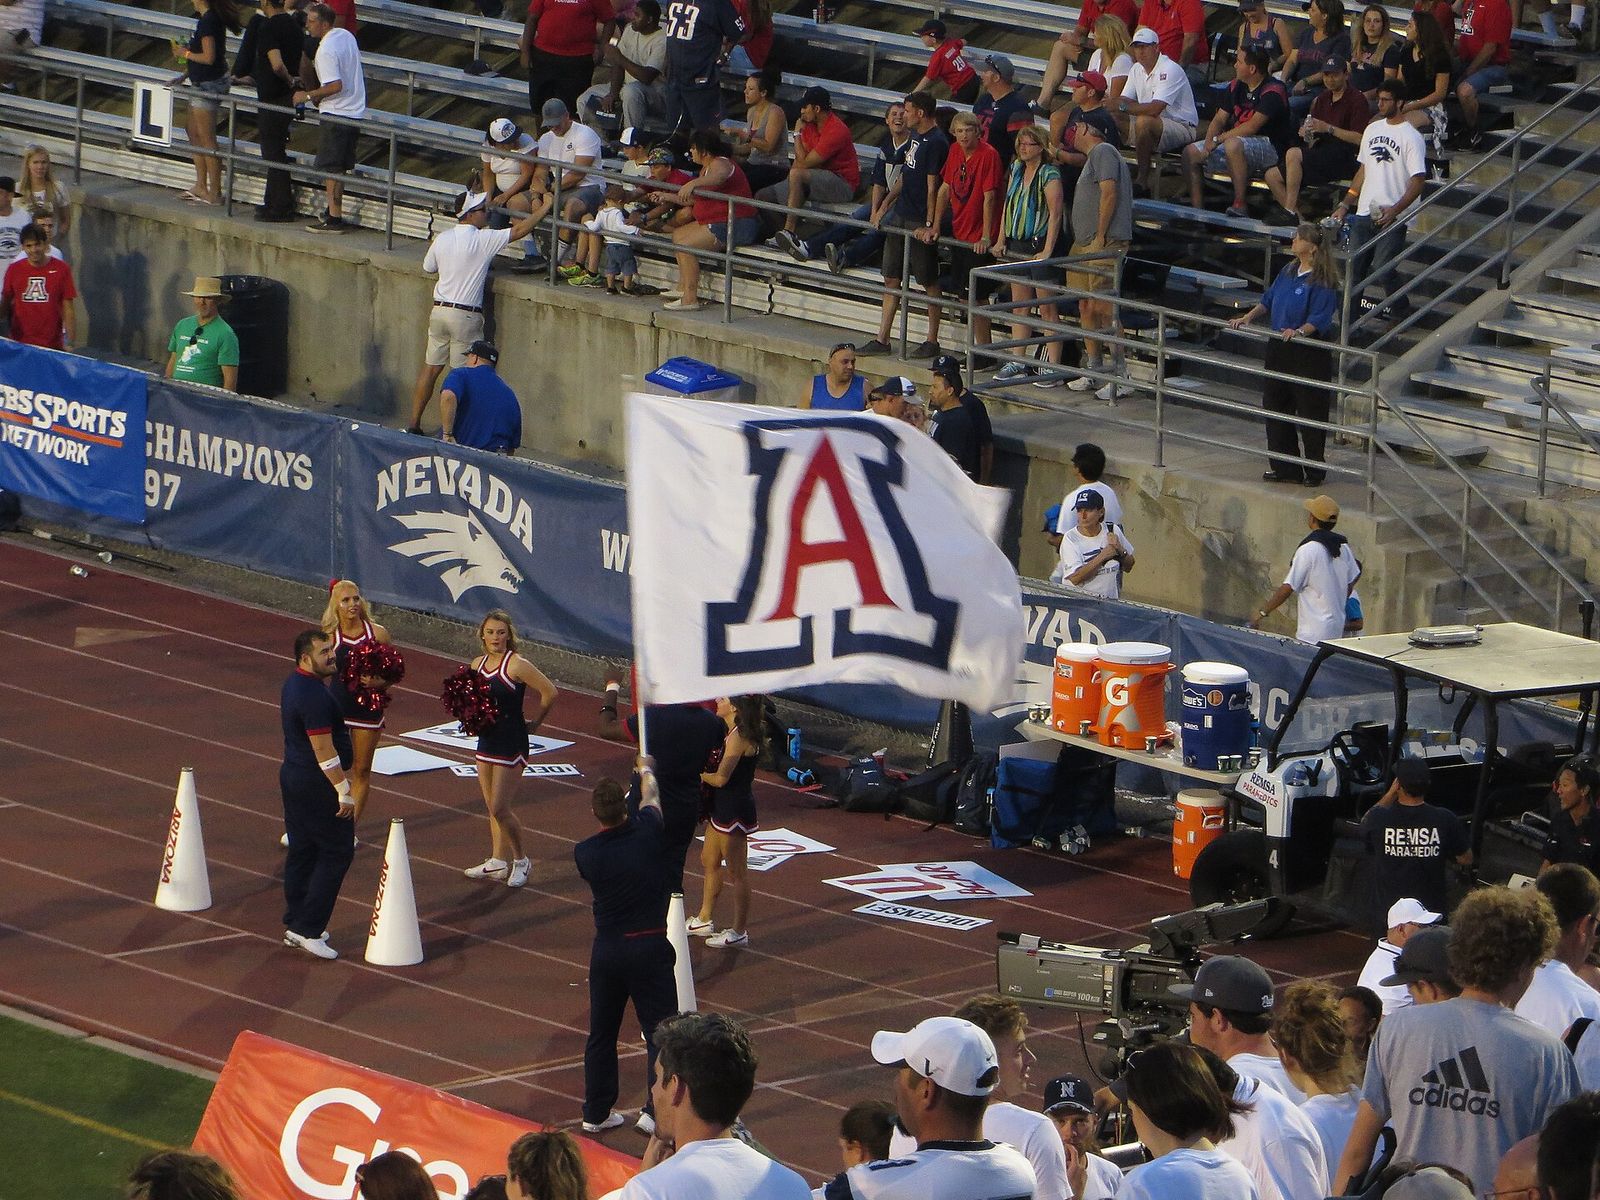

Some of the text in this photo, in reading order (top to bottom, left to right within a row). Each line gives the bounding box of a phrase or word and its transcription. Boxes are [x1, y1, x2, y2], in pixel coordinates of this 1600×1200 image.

[667, 2, 700, 41] 53
[140, 88, 164, 139] L
[1368, 135, 1401, 156] NEVADA
[22, 276, 50, 303] A
[0, 422, 91, 466] NETWORK
[376, 456, 533, 554] NEVADA
[705, 416, 961, 677] A
[1105, 677, 1129, 707] G
[1242, 782, 1279, 808] PARAMEDICS
[1250, 772, 1276, 796] REMSA
[162, 807, 182, 884] ARIZONA
[1384, 827, 1441, 846] REMSA
[1384, 845, 1441, 858] PARAMEDIC
[1269, 850, 1279, 869] 4
[370, 860, 389, 936] ARIZONA
[1060, 1081, 1076, 1098] N
[1408, 1083, 1501, 1119] adidas
